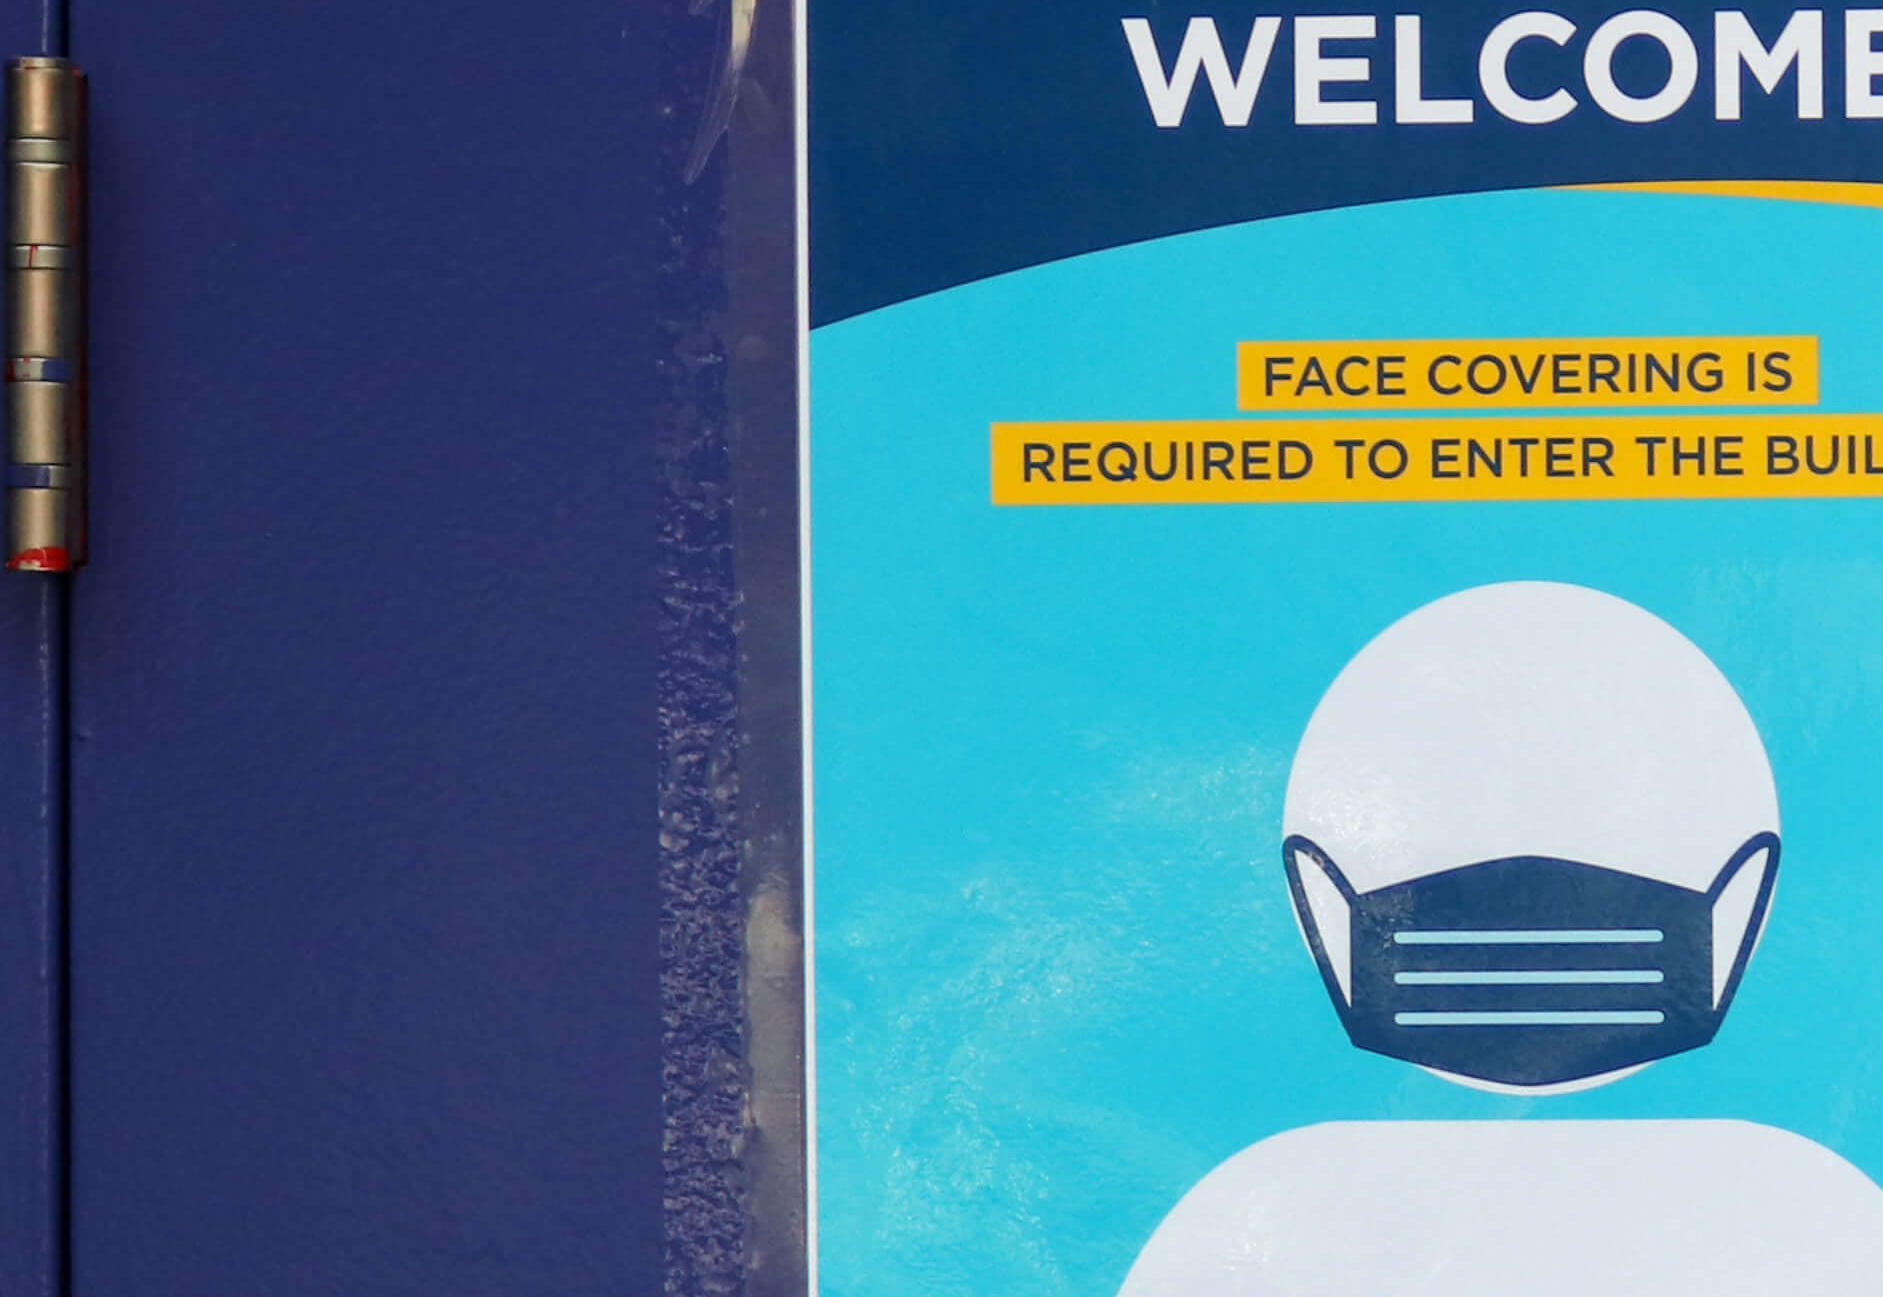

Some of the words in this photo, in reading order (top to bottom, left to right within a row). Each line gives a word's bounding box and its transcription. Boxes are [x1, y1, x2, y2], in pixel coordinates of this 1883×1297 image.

[1265, 355, 1406, 396] FACE
[1428, 352, 1723, 396] COVERING
[1747, 352, 1792, 392] IS
[1023, 440, 1313, 482] REQUIRED
[1334, 439, 1408, 479] TO
[1431, 437, 1614, 479] ENTER
[1635, 436, 1743, 476] THE
